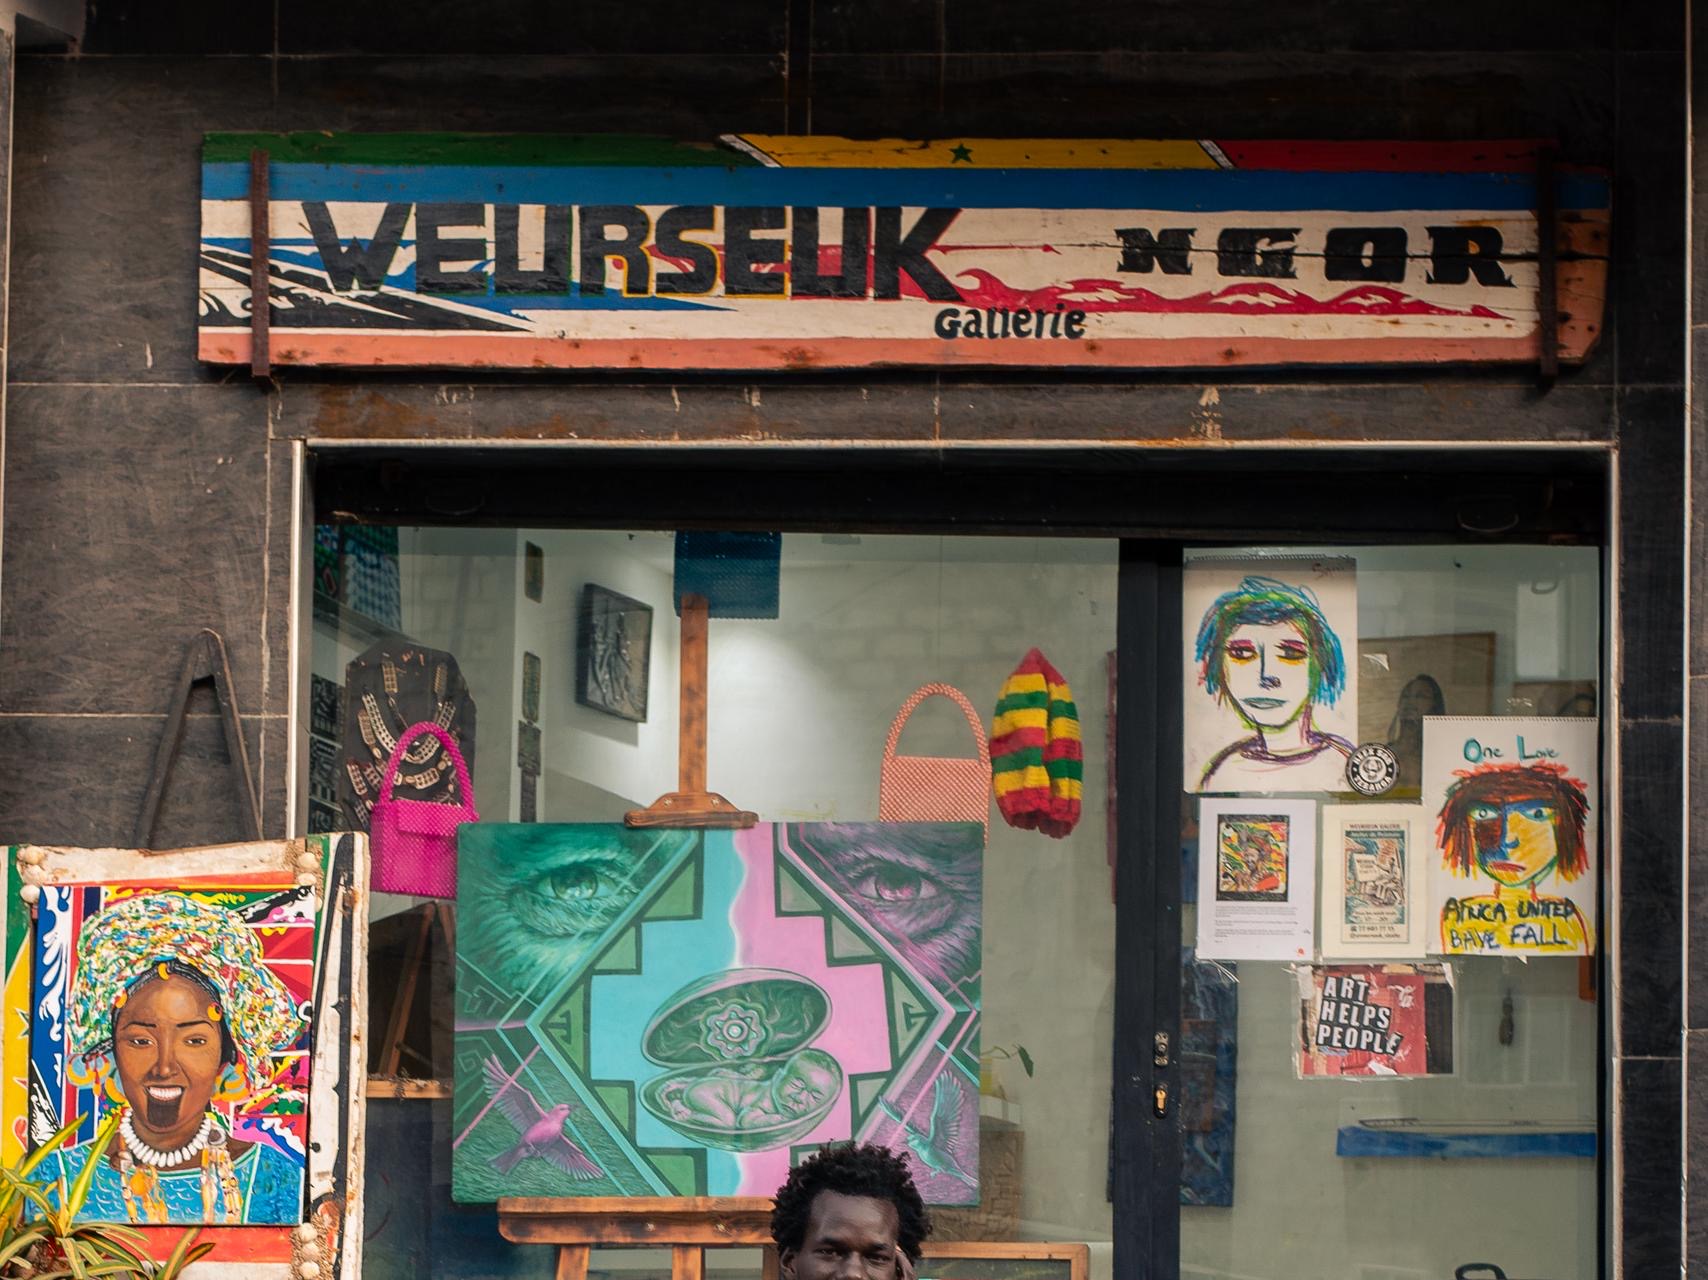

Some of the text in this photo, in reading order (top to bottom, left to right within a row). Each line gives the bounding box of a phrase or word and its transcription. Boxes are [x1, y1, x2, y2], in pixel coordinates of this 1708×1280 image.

[1114, 226, 1518, 288] NGOR
[1463, 735, 1559, 763] One Love
[1444, 897, 1576, 923] AFRICA UNITED
[1511, 923, 1568, 946] FALL
[1323, 976, 1369, 1002] ART
[1320, 1000, 1391, 1030] HELPS
[1317, 1023, 1400, 1055] PEOPLE
